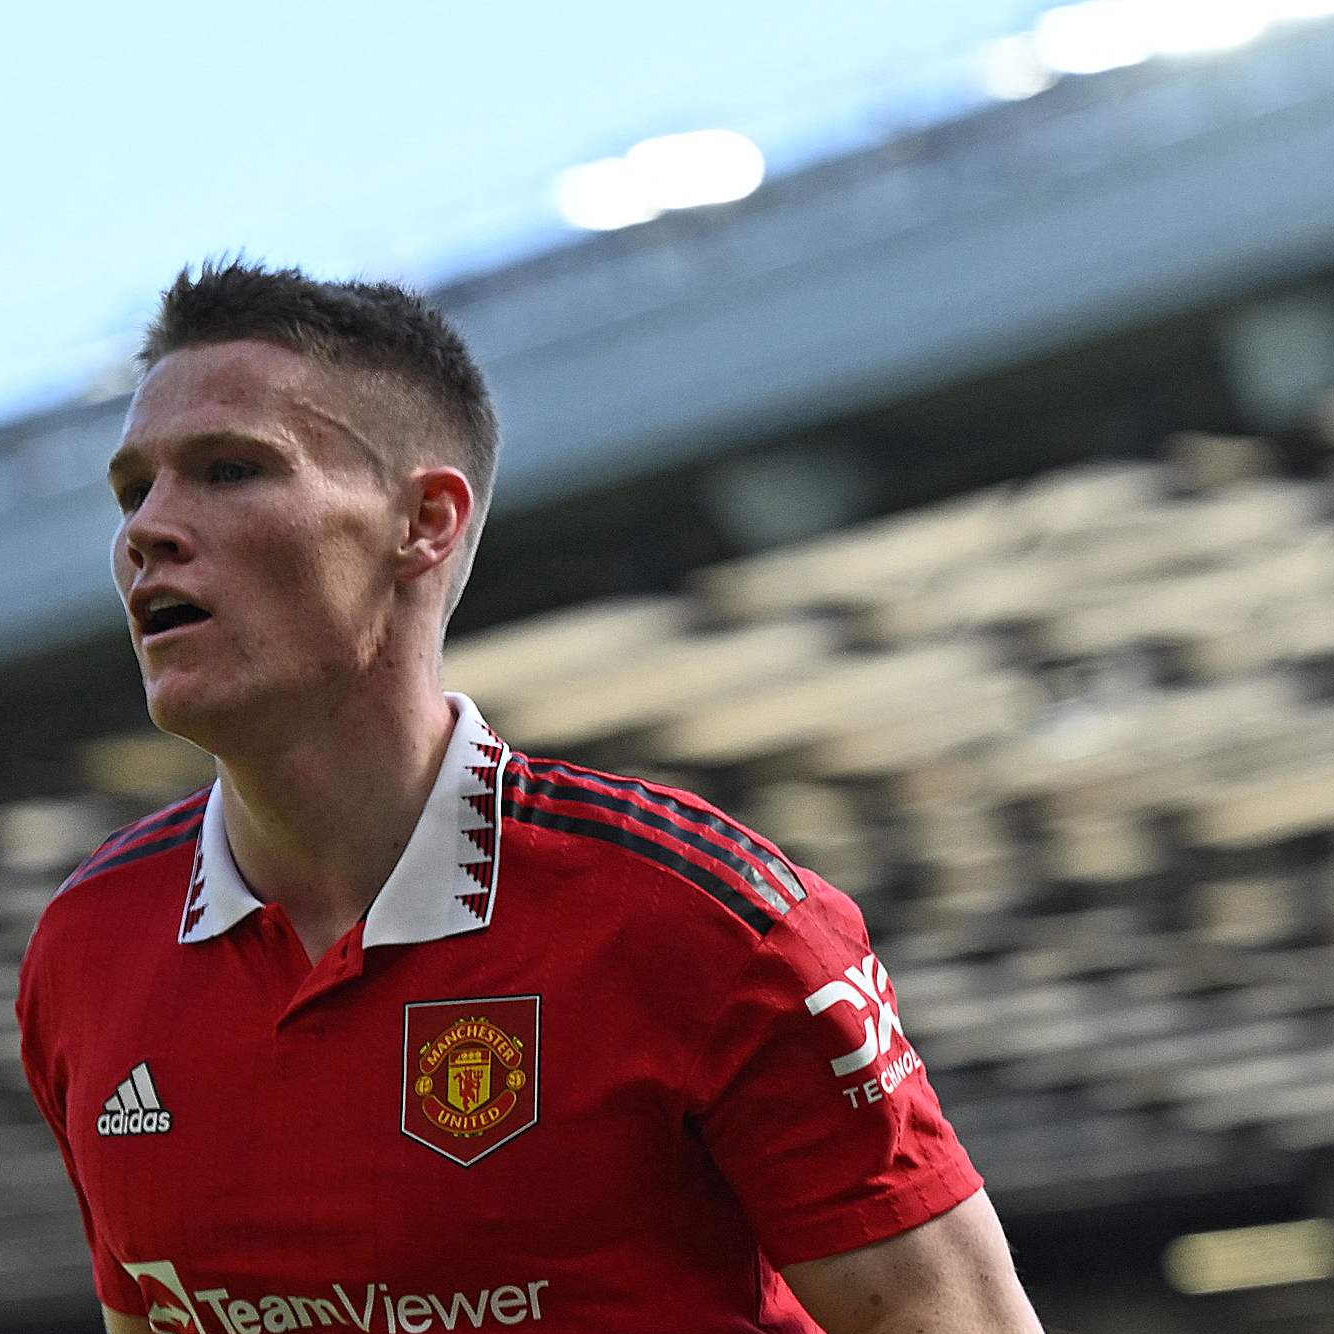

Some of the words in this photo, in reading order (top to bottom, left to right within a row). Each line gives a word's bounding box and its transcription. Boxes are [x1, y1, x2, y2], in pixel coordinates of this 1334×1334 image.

[427, 1025, 514, 1066] MANCHESTER
[97, 1108, 171, 1134] adidas
[438, 1106, 500, 1129] UNITED
